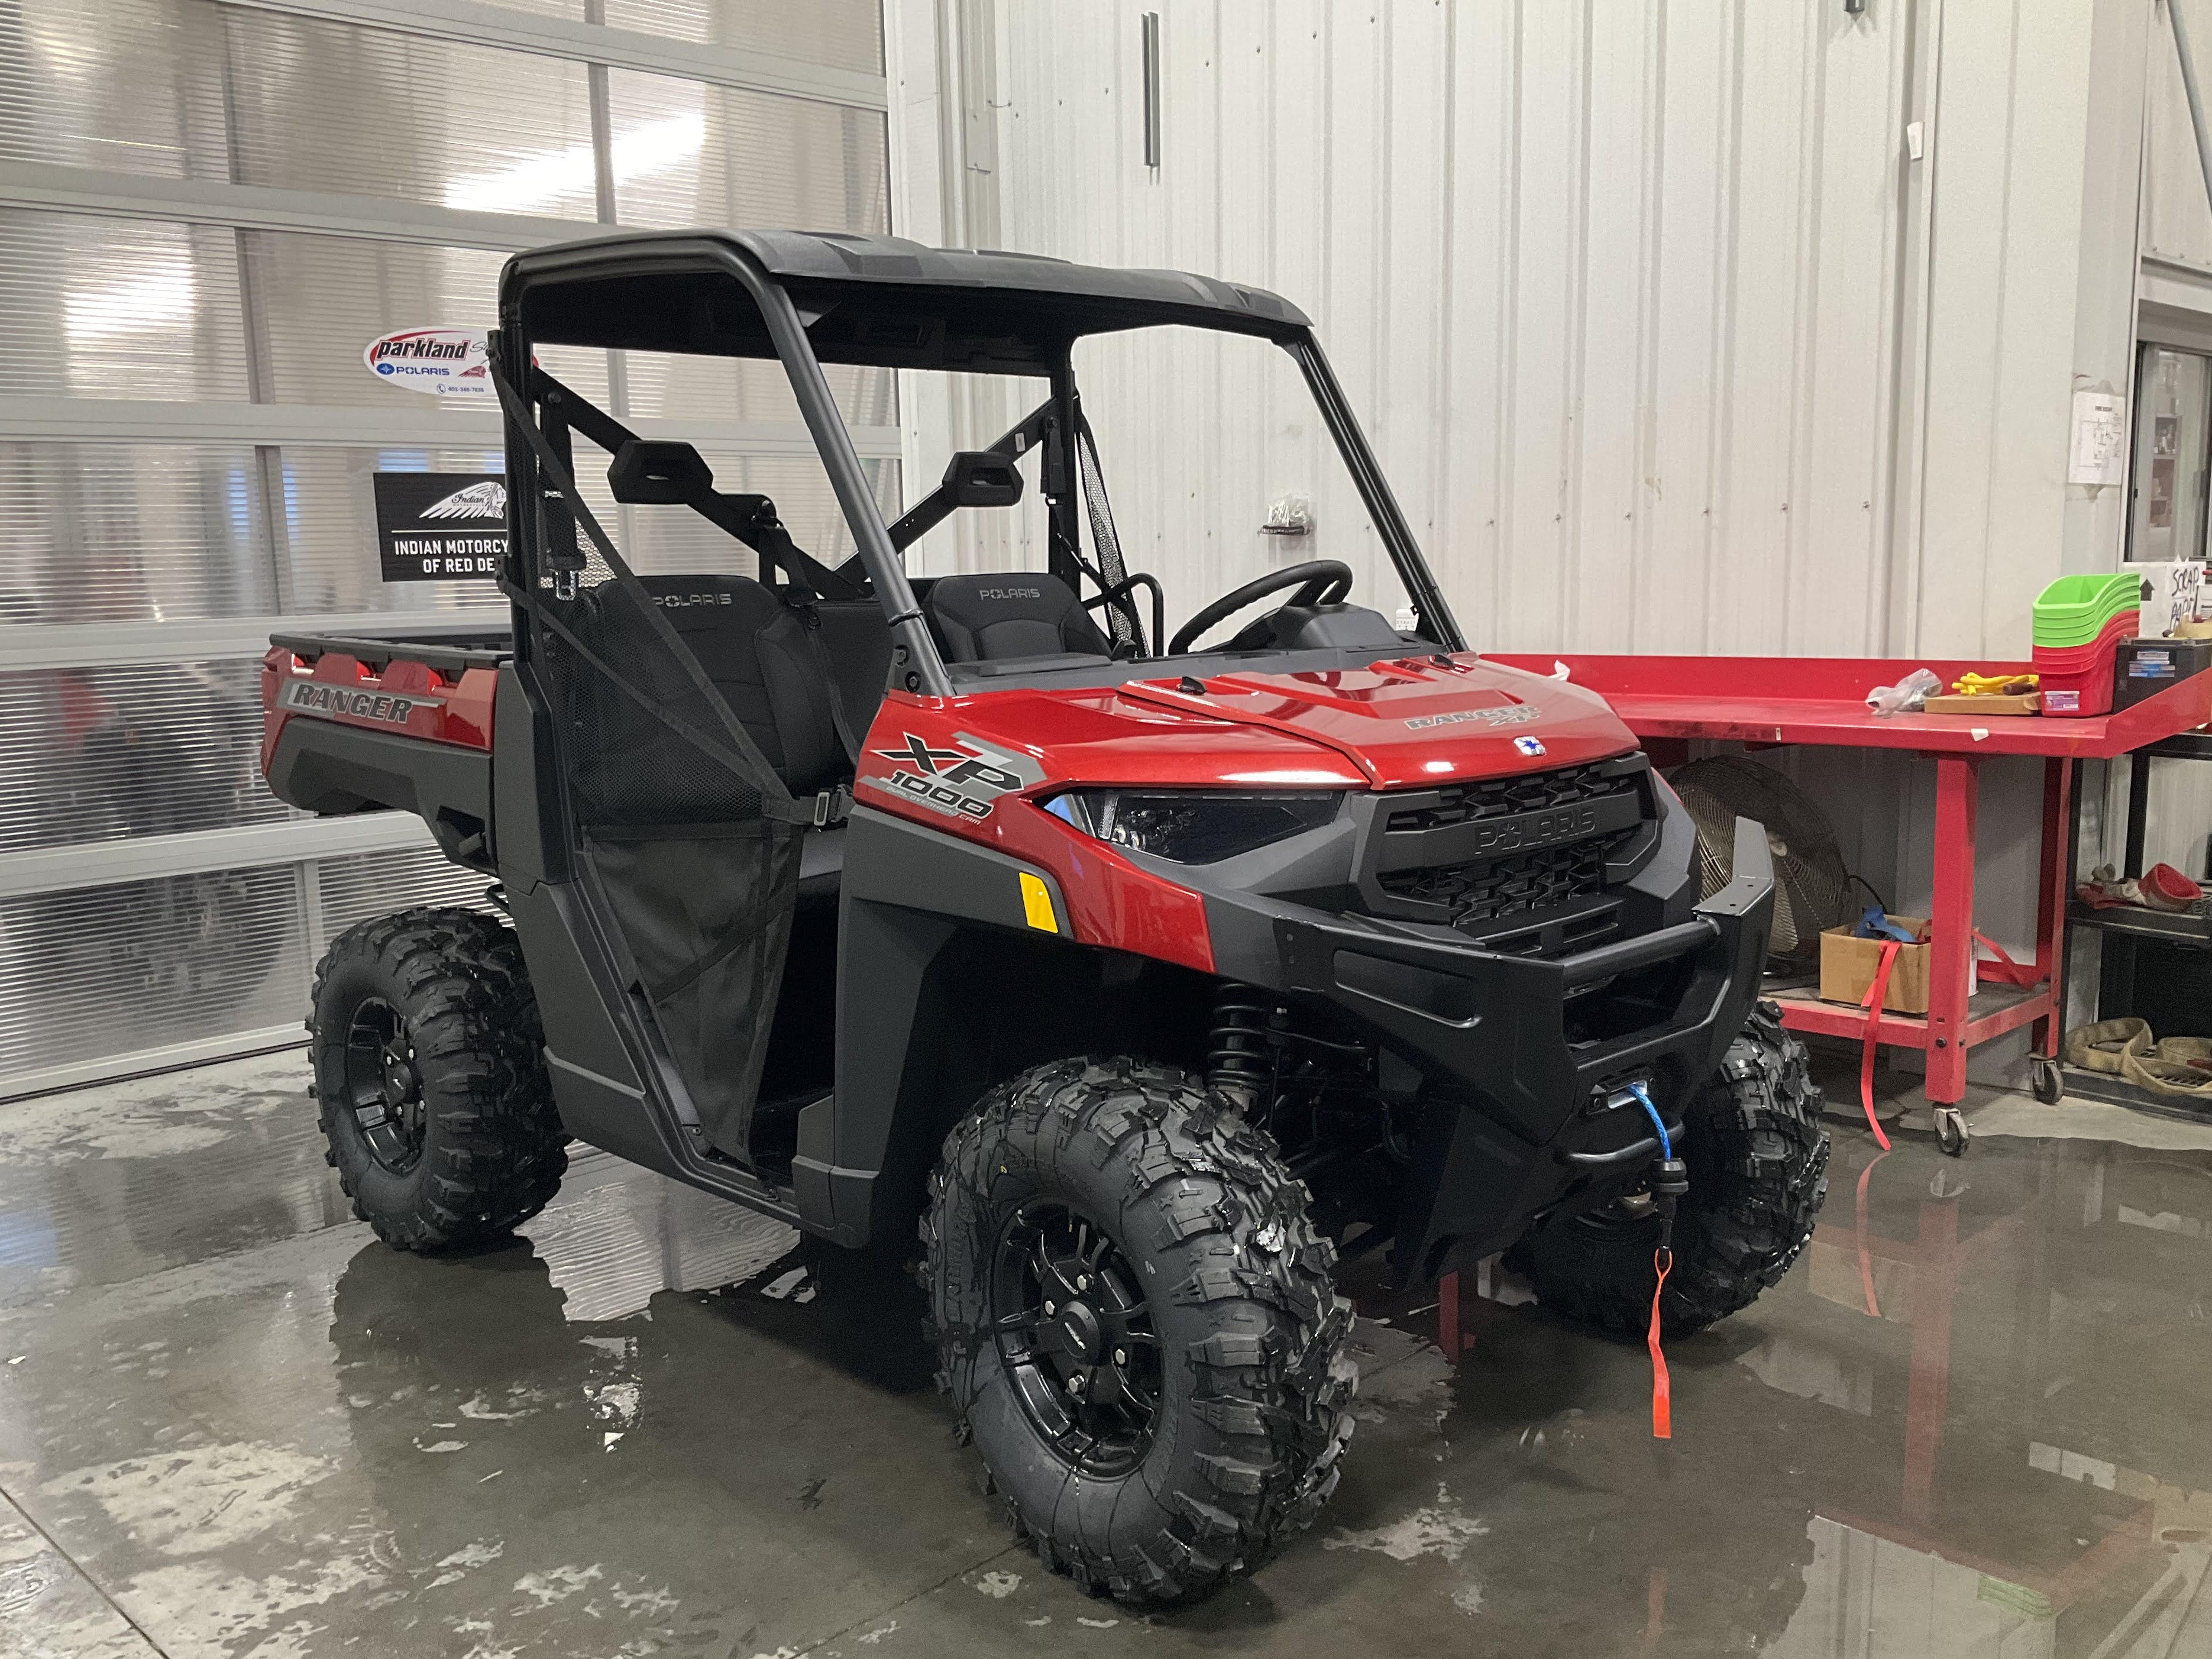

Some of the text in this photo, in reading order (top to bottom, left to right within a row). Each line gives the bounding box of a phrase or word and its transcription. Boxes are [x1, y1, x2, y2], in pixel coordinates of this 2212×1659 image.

[376, 338, 470, 360] parkland
[396, 366, 449, 376] POLARIS
[451, 493, 484, 503] Indian
[394, 539, 508, 555] INDIAN MOTORCY
[423, 558, 495, 573] OF RED DE
[979, 588, 1040, 600] POLARIS
[2171, 566, 2200, 597] SCRAP
[294, 683, 414, 724] RANGER
[1404, 705, 1542, 730] RANGER
[869, 731, 1025, 793] XP
[886, 786, 982, 826] DUAL OVERHEAD CAM
[890, 769, 994, 820] 1000
[1474, 806, 1597, 855] POLARIS
